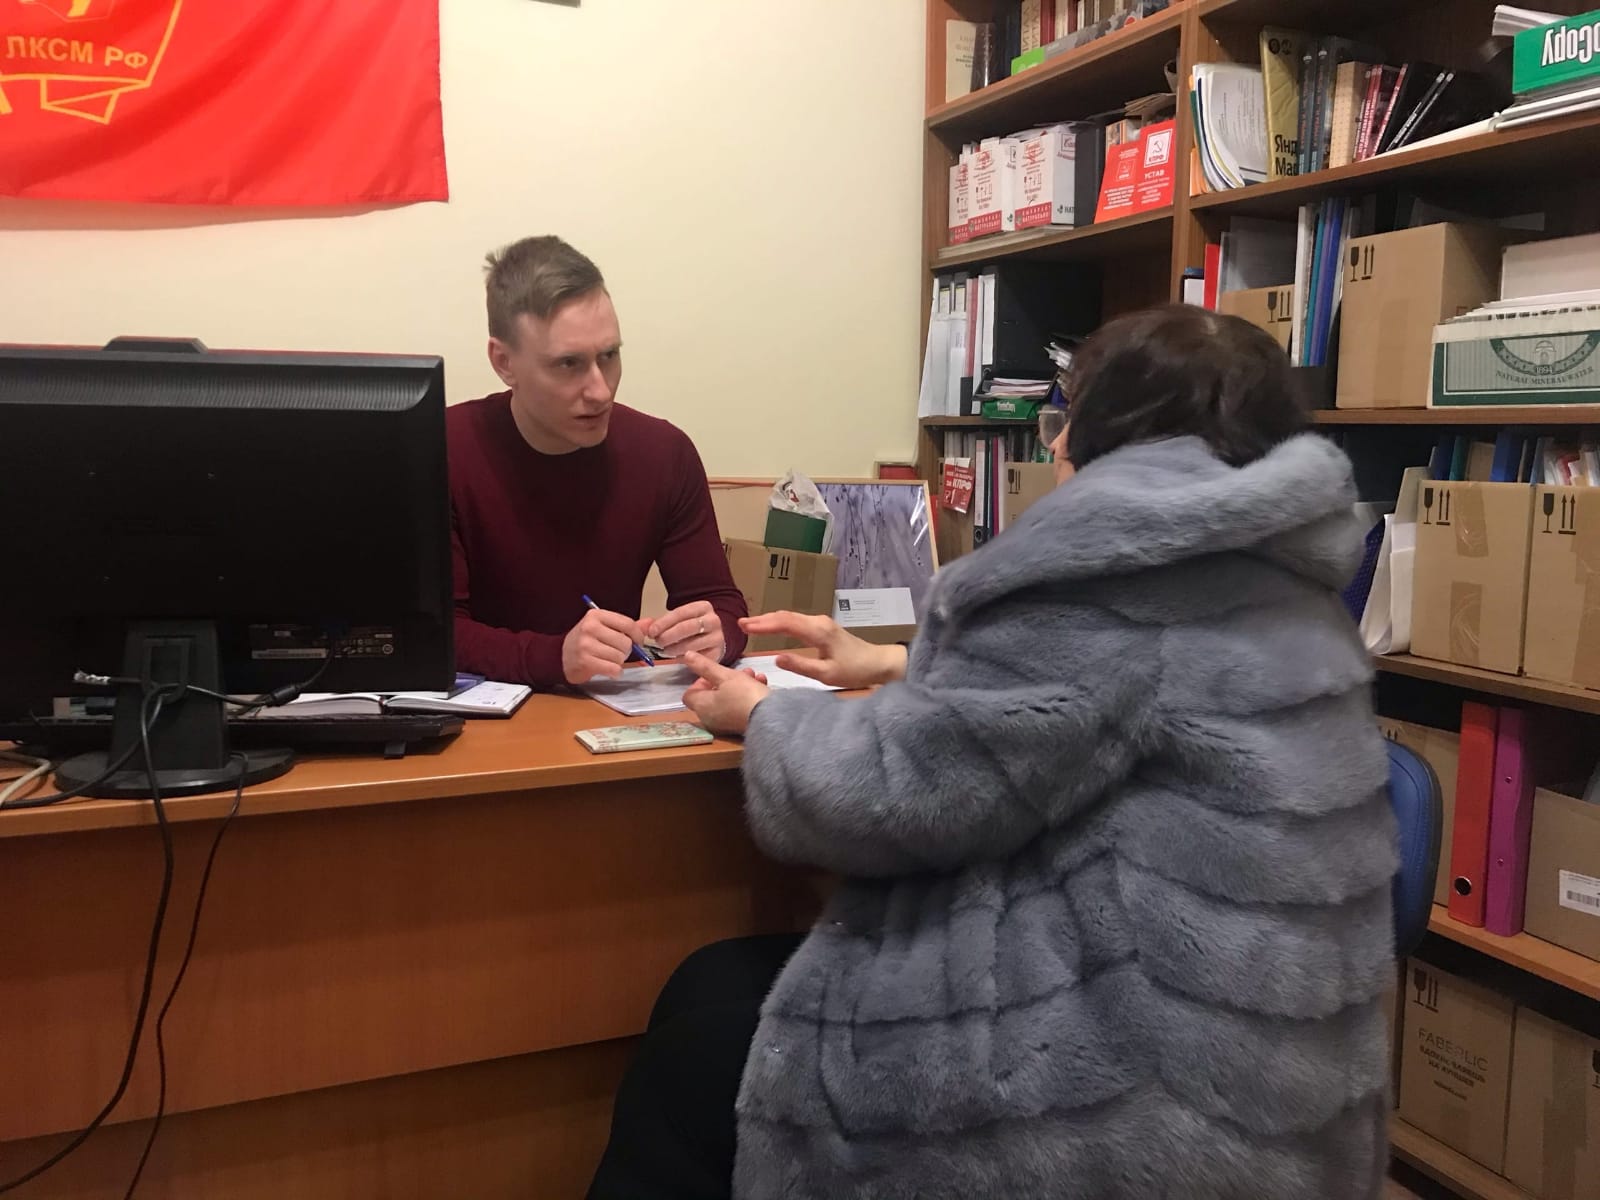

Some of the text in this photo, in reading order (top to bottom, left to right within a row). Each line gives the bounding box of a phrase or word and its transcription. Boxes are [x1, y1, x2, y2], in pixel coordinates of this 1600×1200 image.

[6, 35, 149, 69] ЛКСМ РФ
[1495, 366, 1594, 385] NATURAL MINERAL WATER
[953, 478, 972, 491] КПРФ
